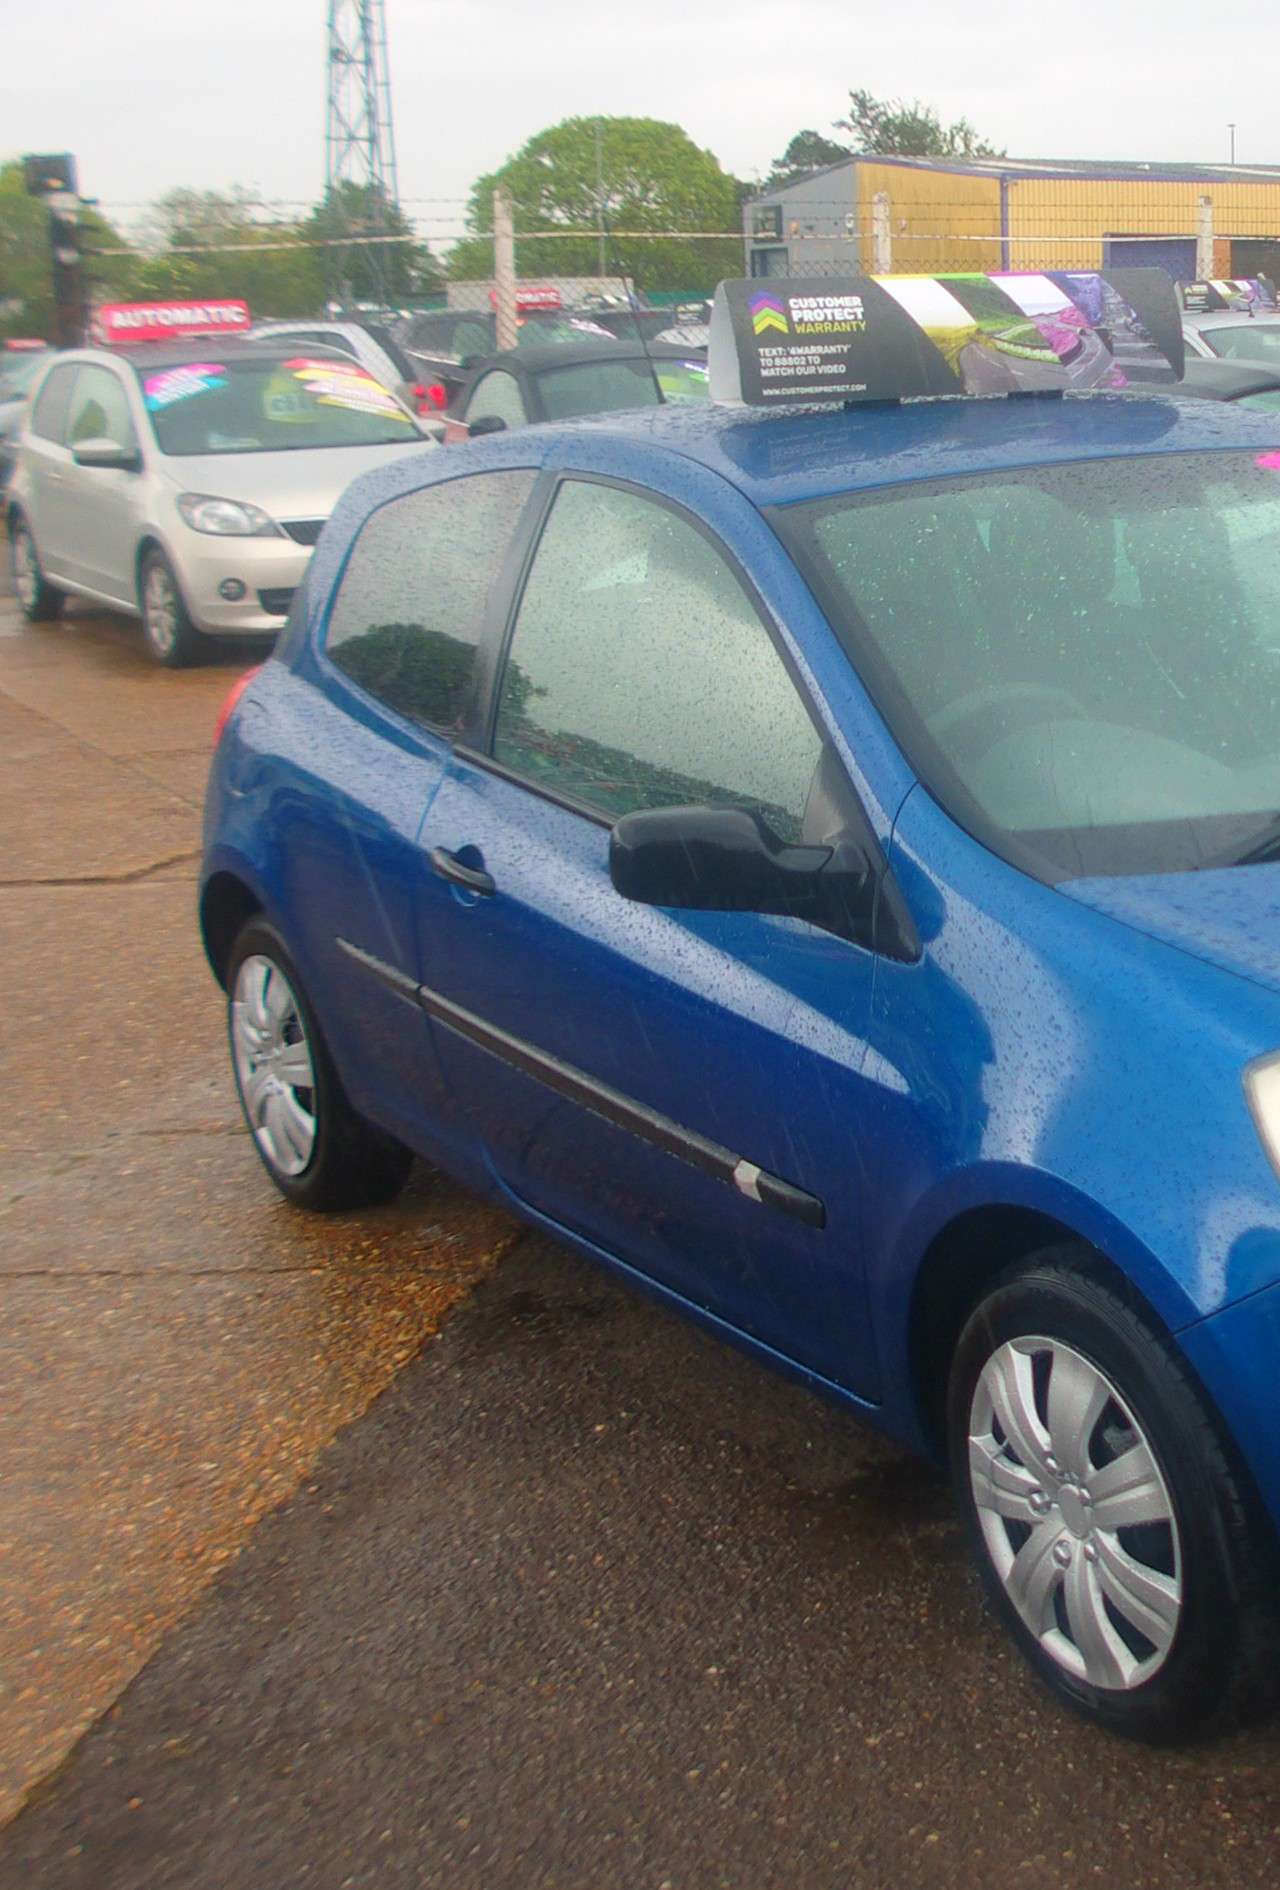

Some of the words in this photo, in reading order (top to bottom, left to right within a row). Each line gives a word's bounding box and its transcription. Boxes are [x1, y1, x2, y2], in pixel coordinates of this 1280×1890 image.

[788, 296, 862, 308] CUSTOMER
[111, 305, 246, 329] AUTOMATIC
[790, 307, 864, 322] PROTECT
[794, 320, 866, 334] WARRANTY
[760, 358, 773, 367] TO
[807, 356, 821, 365] TO
[760, 367, 795, 377] WATCH
[795, 366, 817, 376] OUR
[816, 364, 847, 375] VIDEO
